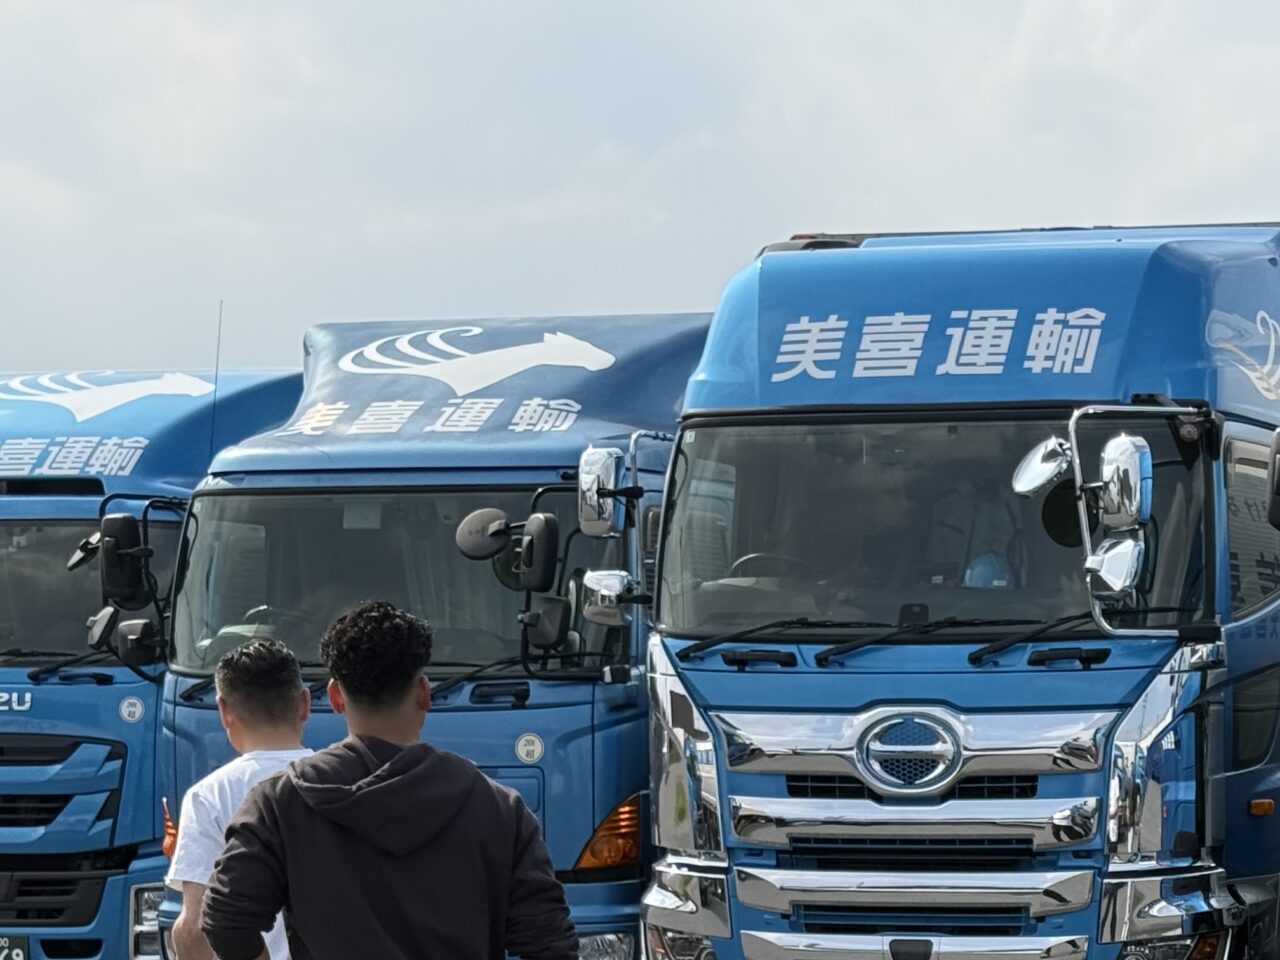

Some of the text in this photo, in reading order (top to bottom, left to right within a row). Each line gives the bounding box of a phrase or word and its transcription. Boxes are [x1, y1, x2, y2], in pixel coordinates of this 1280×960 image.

[770, 307, 1107, 383] 美喜運輸
[275, 397, 582, 437] 美喜運輸
